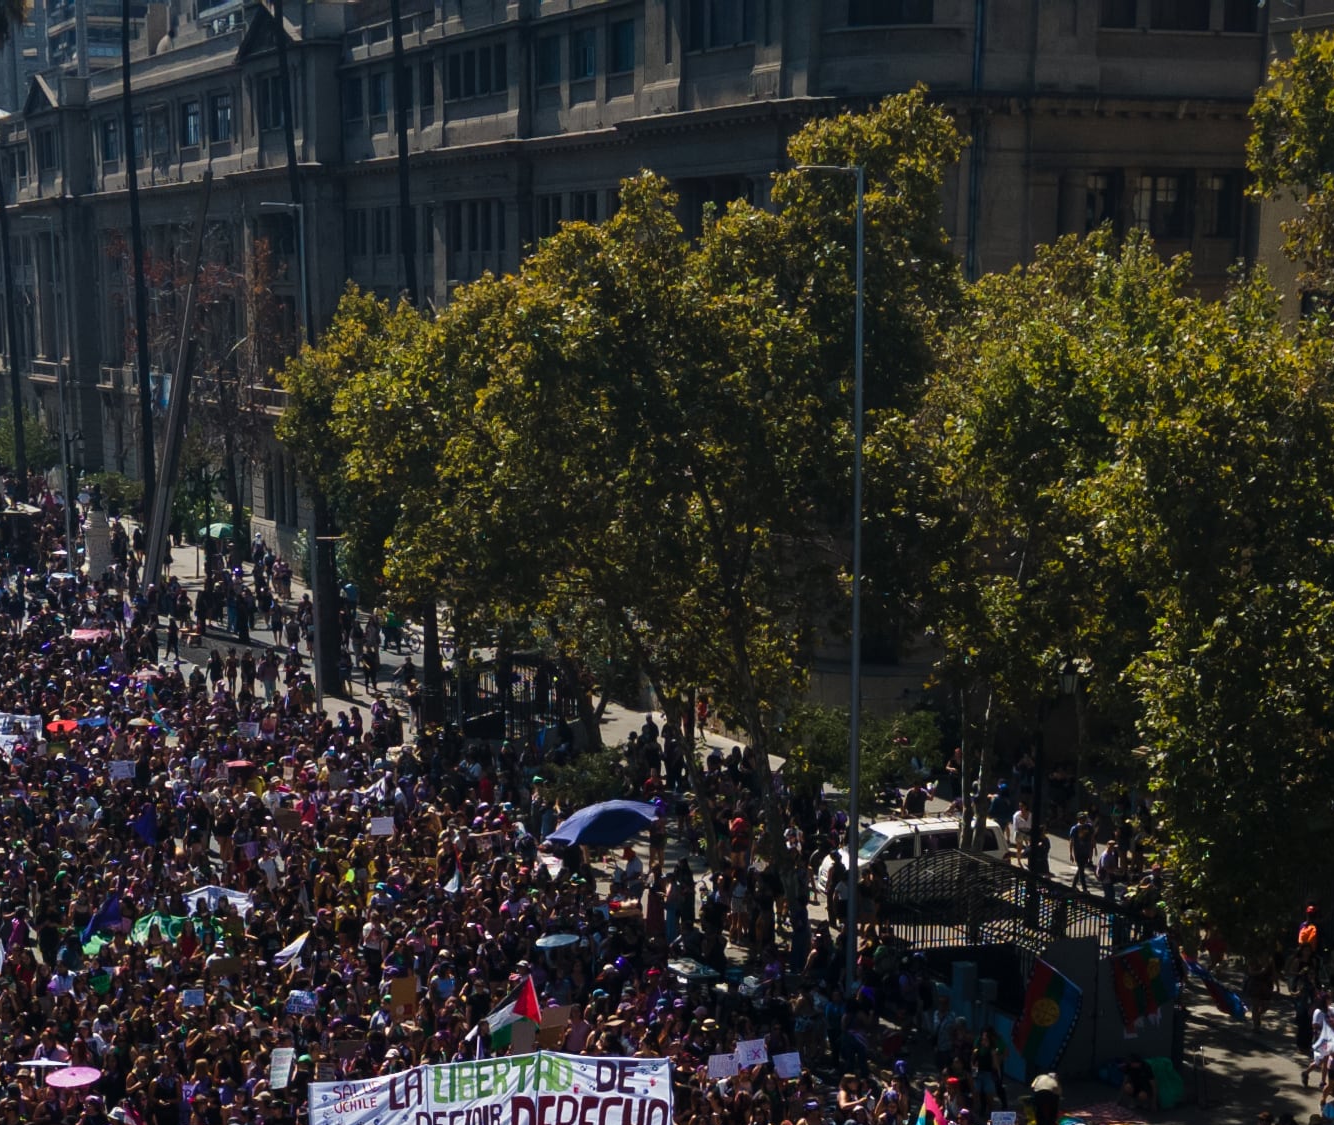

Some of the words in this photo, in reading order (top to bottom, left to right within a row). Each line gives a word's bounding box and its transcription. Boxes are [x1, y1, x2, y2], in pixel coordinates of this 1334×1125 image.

[389, 1068, 423, 1111] LA
[433, 1053, 573, 1104] LIBERTAD
[596, 1060, 639, 1094] DE
